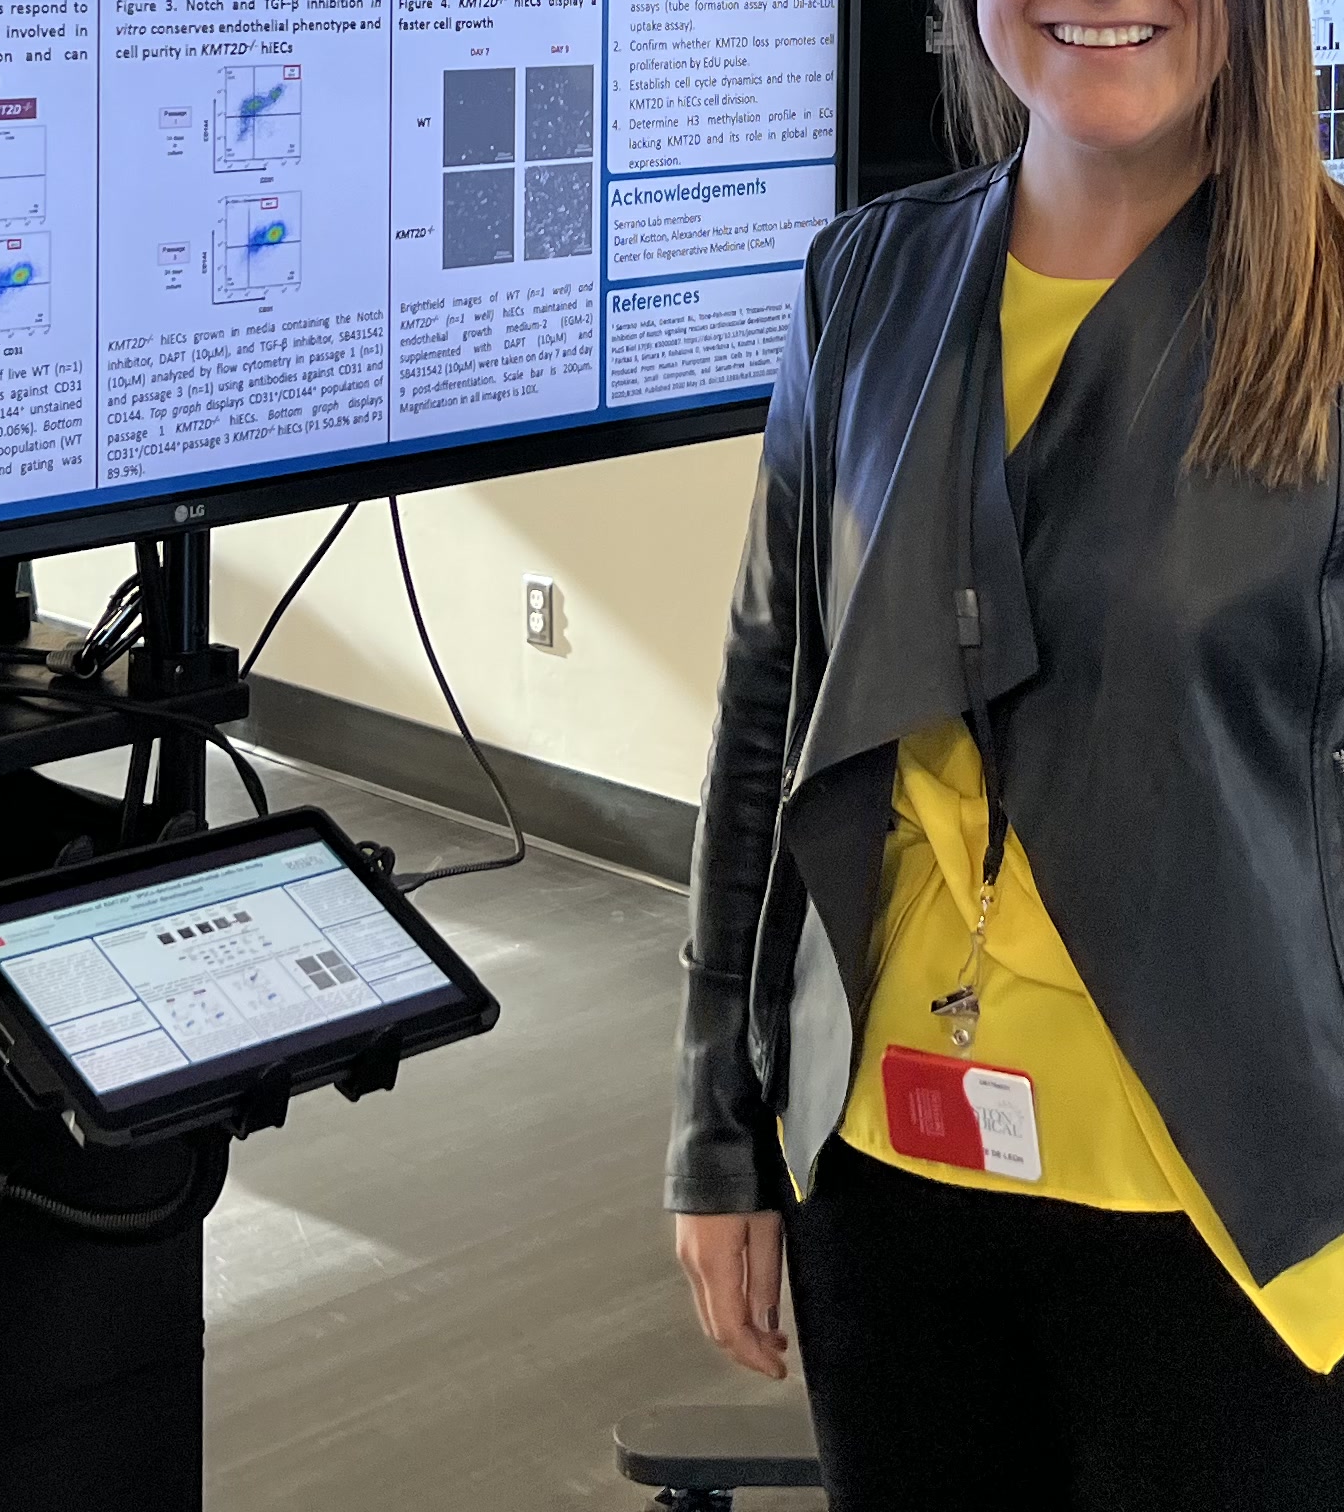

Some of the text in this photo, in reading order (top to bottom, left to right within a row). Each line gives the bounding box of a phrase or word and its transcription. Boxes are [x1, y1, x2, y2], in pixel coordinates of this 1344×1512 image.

[610, 178, 766, 206] Acknowledgements
[612, 290, 699, 312] References
[189, 504, 205, 518] LG
